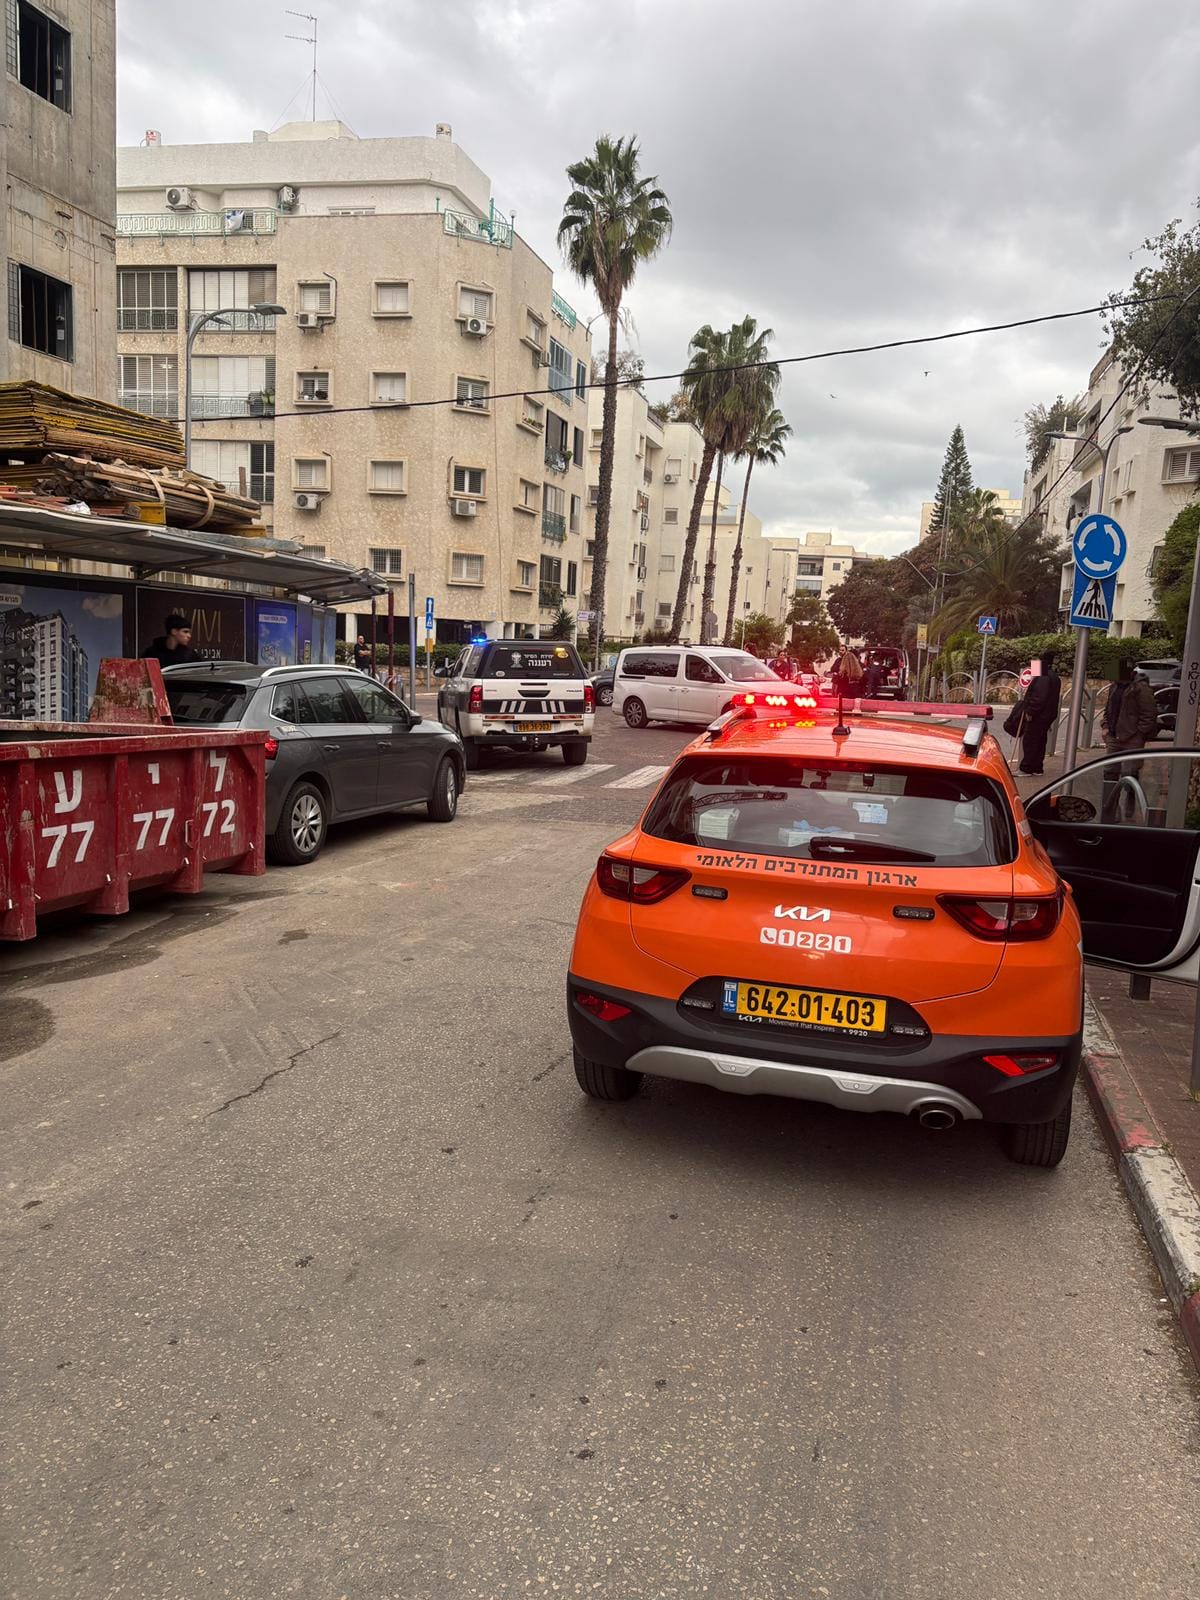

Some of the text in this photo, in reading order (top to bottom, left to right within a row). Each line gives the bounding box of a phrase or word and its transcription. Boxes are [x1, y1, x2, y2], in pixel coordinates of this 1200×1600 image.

[528, 659, 552, 667] רעננה
[54, 769, 83, 814] ע
[42, 799, 236, 868] 77 77 72
[696, 853, 918, 888] ארגון המתנדבים הלאומי
[774, 904, 830, 922] KIA
[777, 929, 852, 953] 1221
[848, 1029, 868, 1037] 9920
